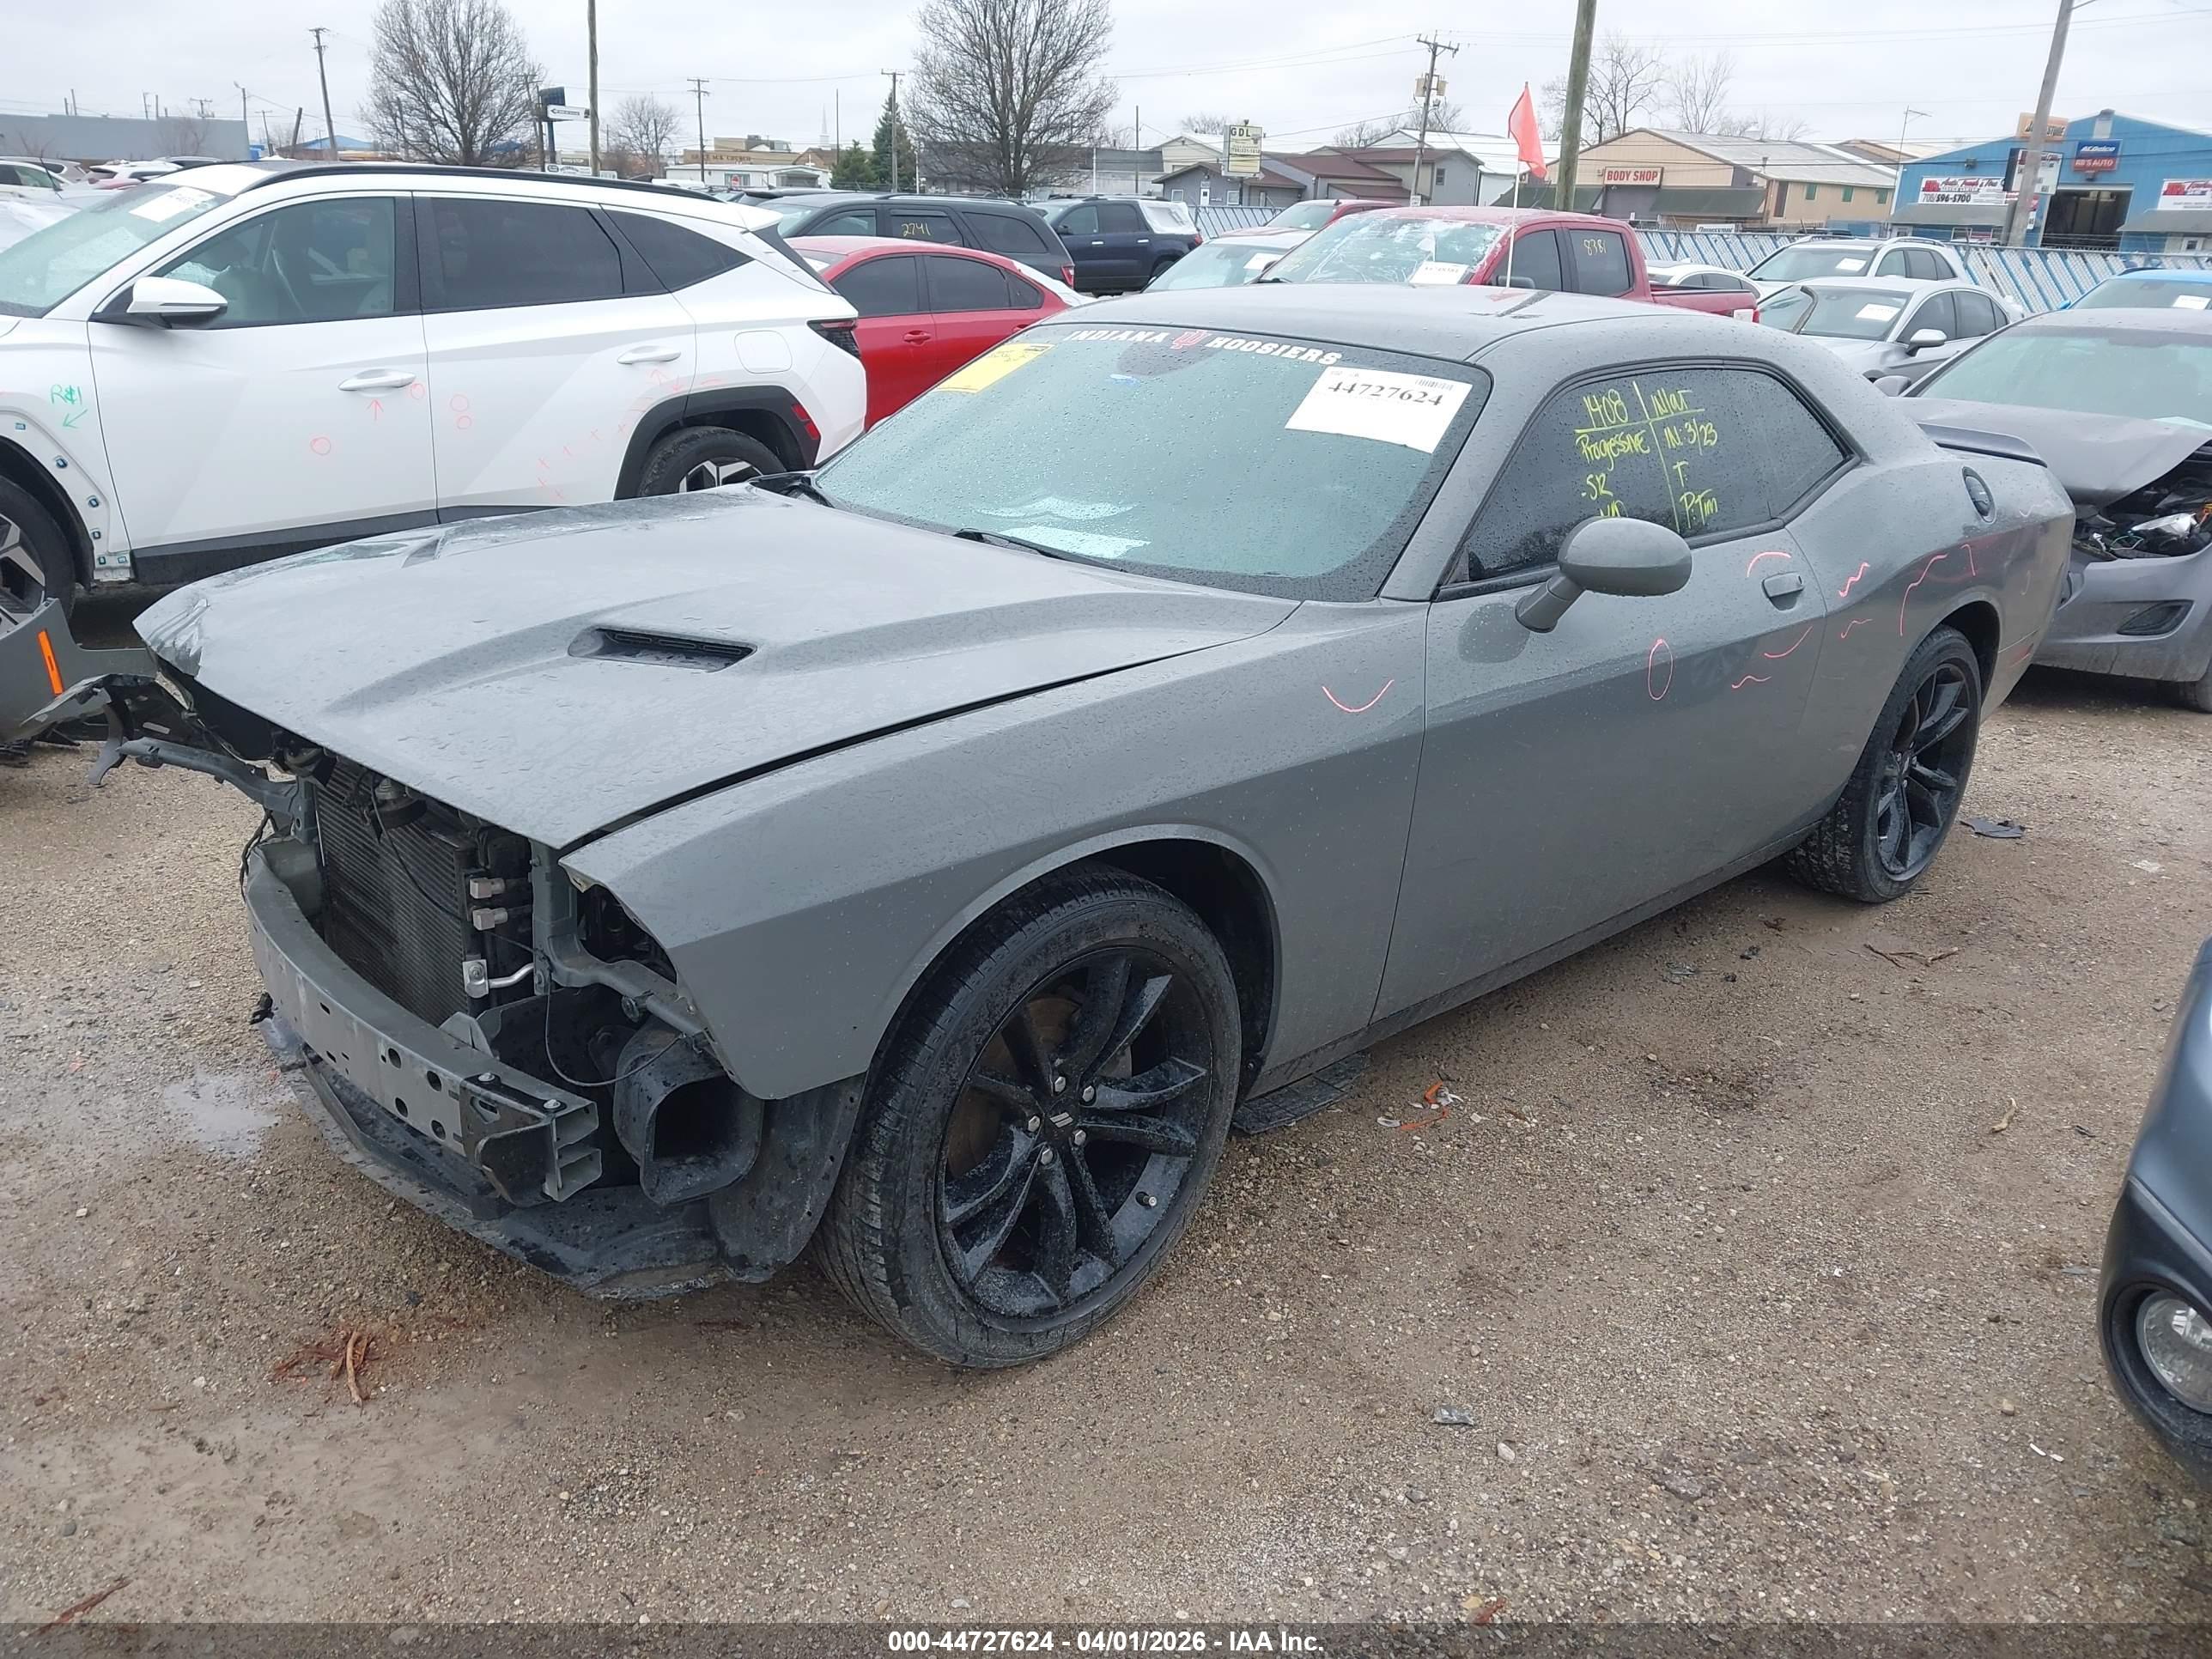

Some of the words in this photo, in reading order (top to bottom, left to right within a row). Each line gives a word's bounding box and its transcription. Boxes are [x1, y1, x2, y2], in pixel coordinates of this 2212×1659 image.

[1607, 171, 1632, 181] BODY
[1633, 171, 1658, 181] SHOP
[901, 222, 931, 237] 2741
[1063, 330, 1171, 343] INDIANA
[1205, 337, 1343, 366] HOOSIERS
[1328, 380, 1444, 406] 44727624
[1583, 388, 1629, 428] 1408
